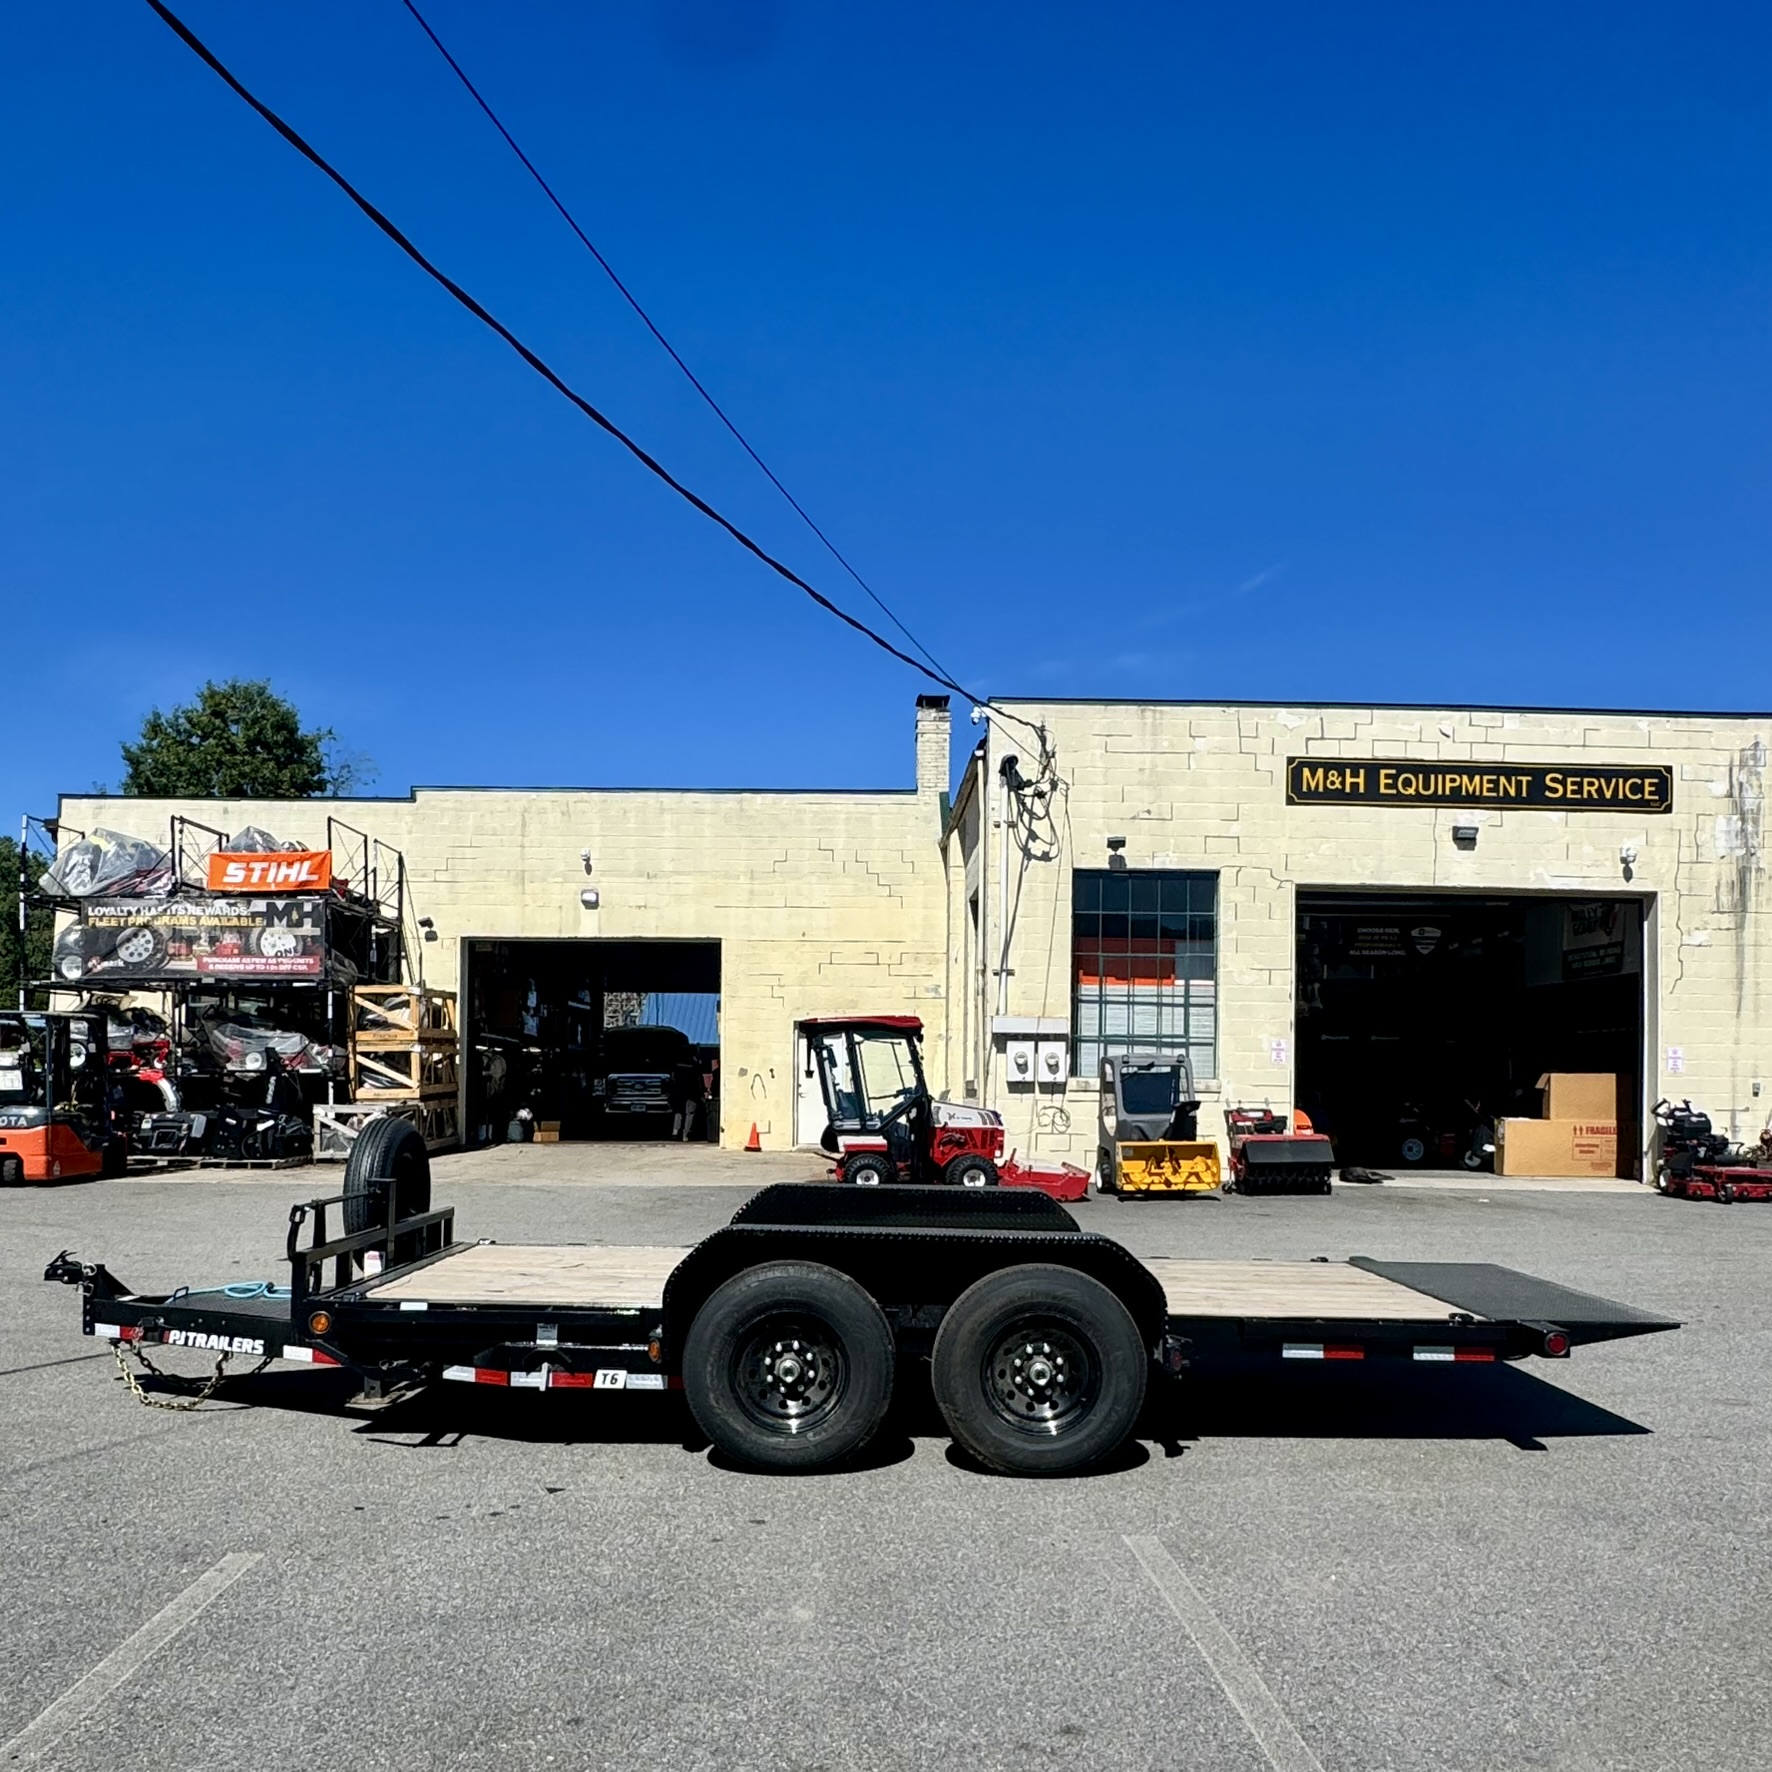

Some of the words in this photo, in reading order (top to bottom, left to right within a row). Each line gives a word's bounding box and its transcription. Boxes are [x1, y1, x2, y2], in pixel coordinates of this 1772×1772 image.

[1302, 767, 1365, 793] M&H
[1379, 769, 1532, 798] EQUIPMENT
[1544, 773, 1659, 800] SERVICE
[222, 861, 319, 883] STIHL
[88, 906, 138, 916] LOYALTY
[88, 916, 126, 927] FLEET
[199, 917, 263, 926] AVAILABLE
[168, 1330, 187, 1345] PJ
[187, 1331, 265, 1355] TRAILERS
[602, 1372, 619, 1385] T6
